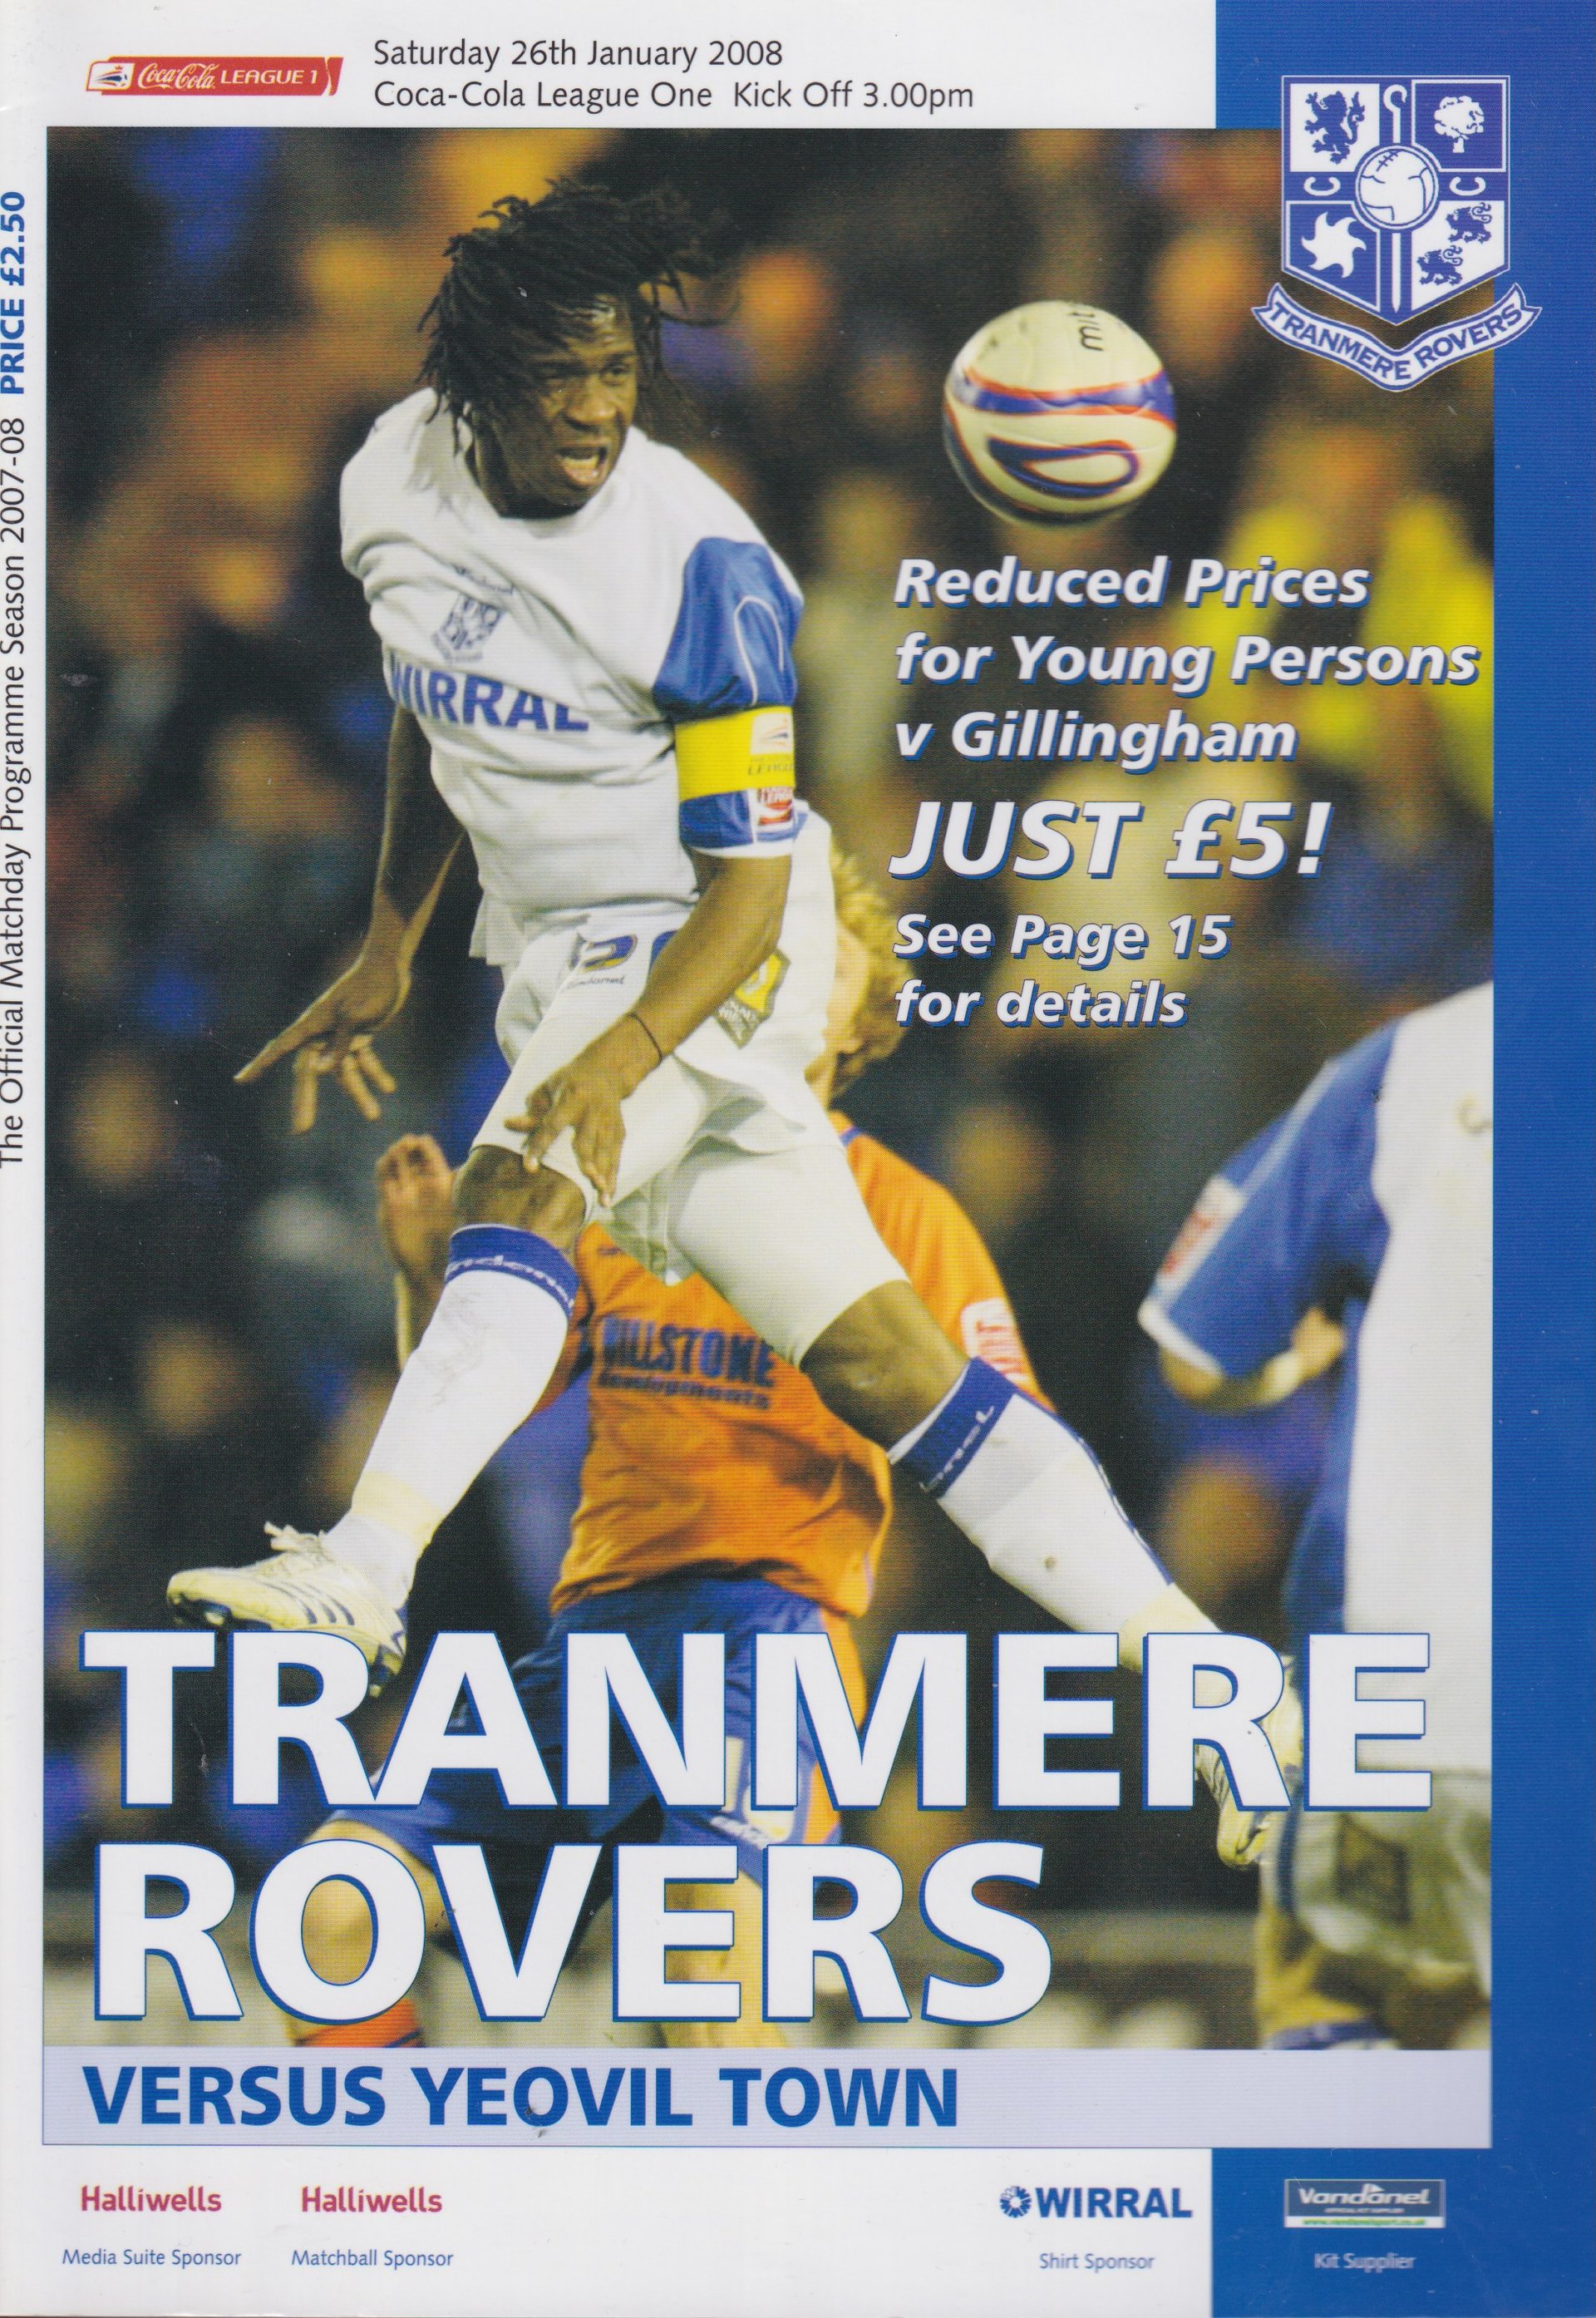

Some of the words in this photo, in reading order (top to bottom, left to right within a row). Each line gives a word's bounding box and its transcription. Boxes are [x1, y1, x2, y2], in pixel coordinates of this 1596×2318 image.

[220, 70, 305, 84] LEAGUE
[310, 70, 318, 84] 1
[375, 38, 500, 72] Saturday
[512, 39, 576, 66] 26th
[588, 40, 697, 73] January
[709, 40, 783, 66] 2008
[375, 80, 526, 107] Coca-Cola
[538, 81, 639, 114] League
[652, 81, 712, 107] One
[735, 81, 792, 107] Kick
[804, 80, 853, 107] Off
[864, 81, 973, 115] 3.00pm
[0, 191, 25, 286] £2.50
[0, 299, 25, 394] PRICE
[1271, 301, 1414, 382] TRANMERE
[1414, 303, 1524, 369] ROVERS
[0, 417, 25, 544] 2007-08
[0, 556, 25, 654] Season
[893, 555, 1170, 608] Reduced
[1184, 555, 1372, 608] Prices
[390, 651, 589, 732] WIRRAL
[895, 632, 993, 684] for
[1012, 635, 1214, 697] Young
[1230, 635, 1481, 684] Persons
[0, 667, 32, 831] Programme
[895, 723, 935, 760] v
[952, 709, 1299, 774] Gillingham
[887, 801, 1143, 880] JUST
[1164, 801, 1334, 880] £5!
[0, 844, 32, 989] Matchday
[892, 914, 995, 959] See
[1009, 915, 1150, 970] Page
[1170, 915, 1234, 959] 15
[894, 979, 982, 1028] for
[996, 979, 1189, 1028] details
[0, 1001, 23, 1104] Official
[0, 1116, 23, 1169] The
[81, 1630, 1433, 1812] TRANMERE
[93, 1839, 1054, 2025] ROVERS
[82, 2065, 387, 2127] VERSUS
[411, 2066, 693, 2128] YEOVIL
[719, 2067, 958, 2128] TOWN
[81, 2186, 222, 2212] Halliwells
[301, 2187, 443, 2213] Halliwells
[1036, 2187, 1194, 2219] WIRRAL
[1298, 2183, 1431, 2204] Vandanel
[62, 2248, 117, 2266] Media
[123, 2249, 165, 2266] Suite
[172, 2249, 241, 2269] Sponsor
[292, 2249, 377, 2266] Matchball
[384, 2250, 454, 2270] Sponsor
[1040, 2253, 1079, 2269] Shirt
[1084, 2253, 1155, 2274] Sponsor
[1314, 2253, 1340, 2268] Kit
[1343, 2252, 1416, 2273] Supplier
